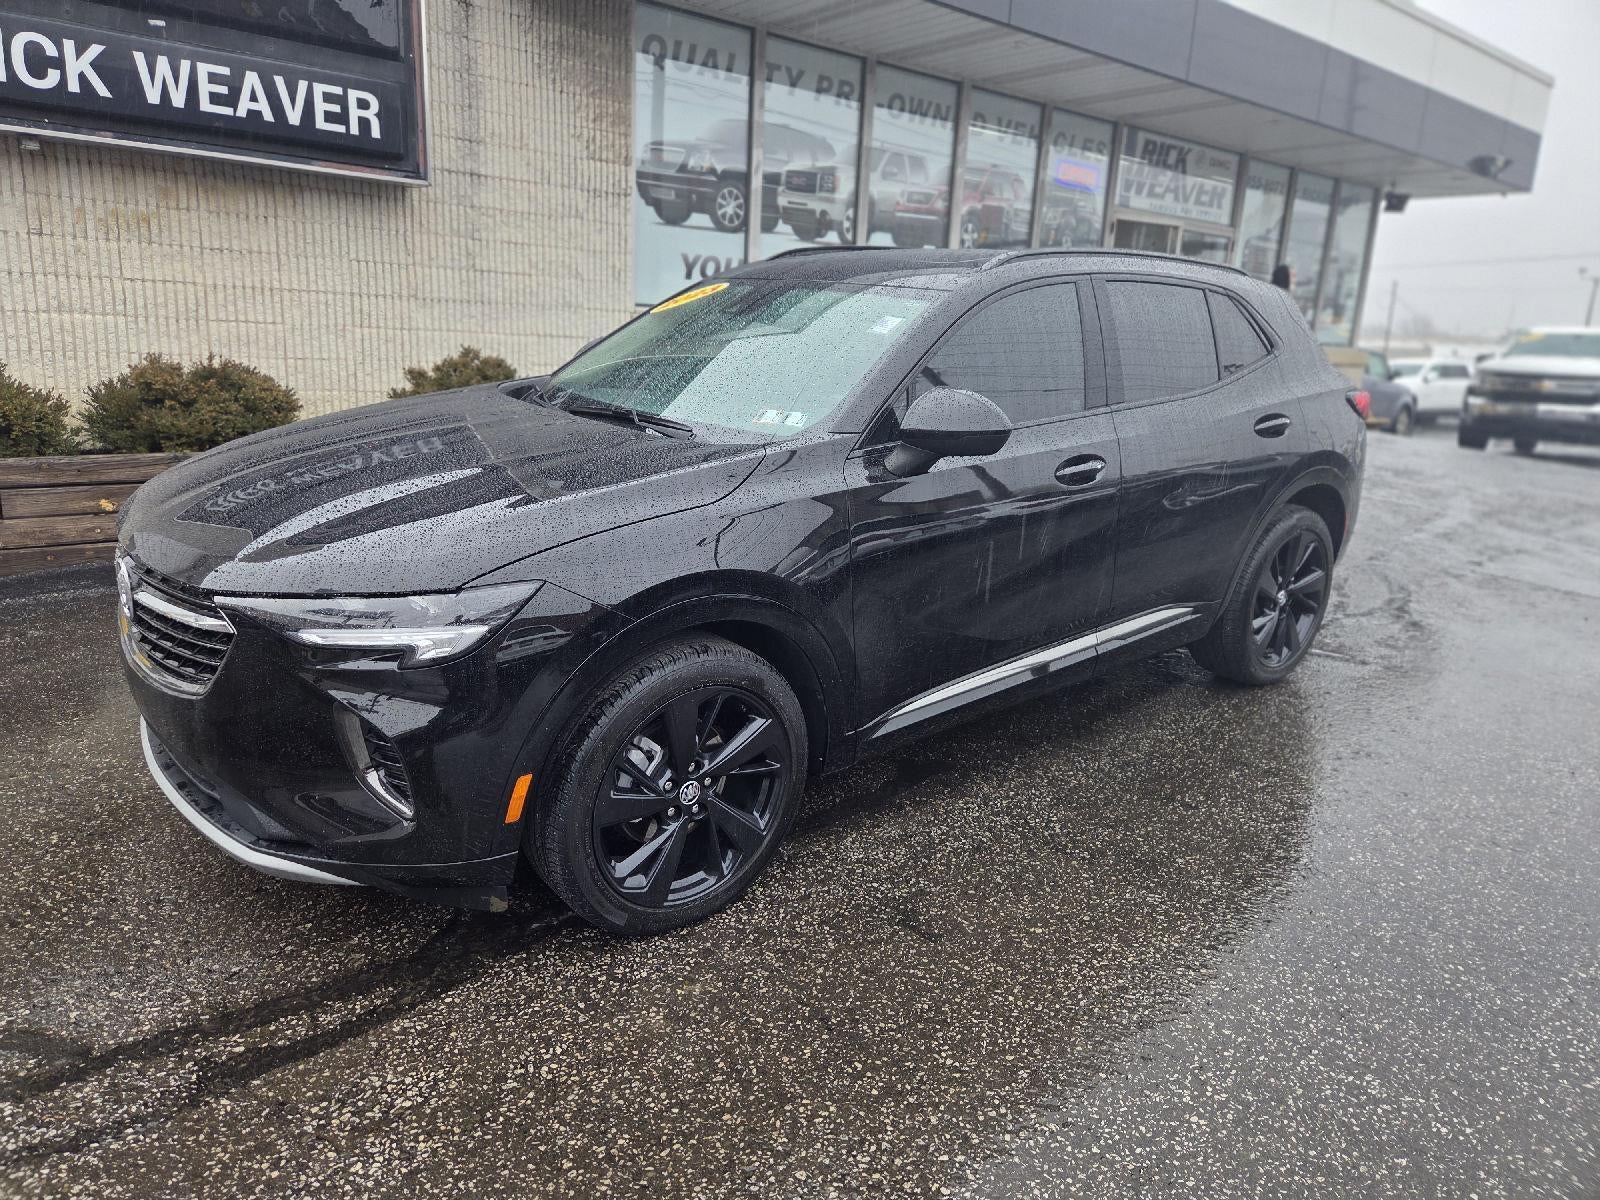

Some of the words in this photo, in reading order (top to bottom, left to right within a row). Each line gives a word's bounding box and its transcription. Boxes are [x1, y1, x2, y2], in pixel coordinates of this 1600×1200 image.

[133, 51, 381, 139] WEAVER
[641, 34, 805, 95] QUALTY
[814, 74, 988, 136] PR-OWND
[997, 116, 1107, 161] VEHCLES
[1121, 162, 1228, 210] WEAVER
[1140, 138, 1192, 174] RICK
